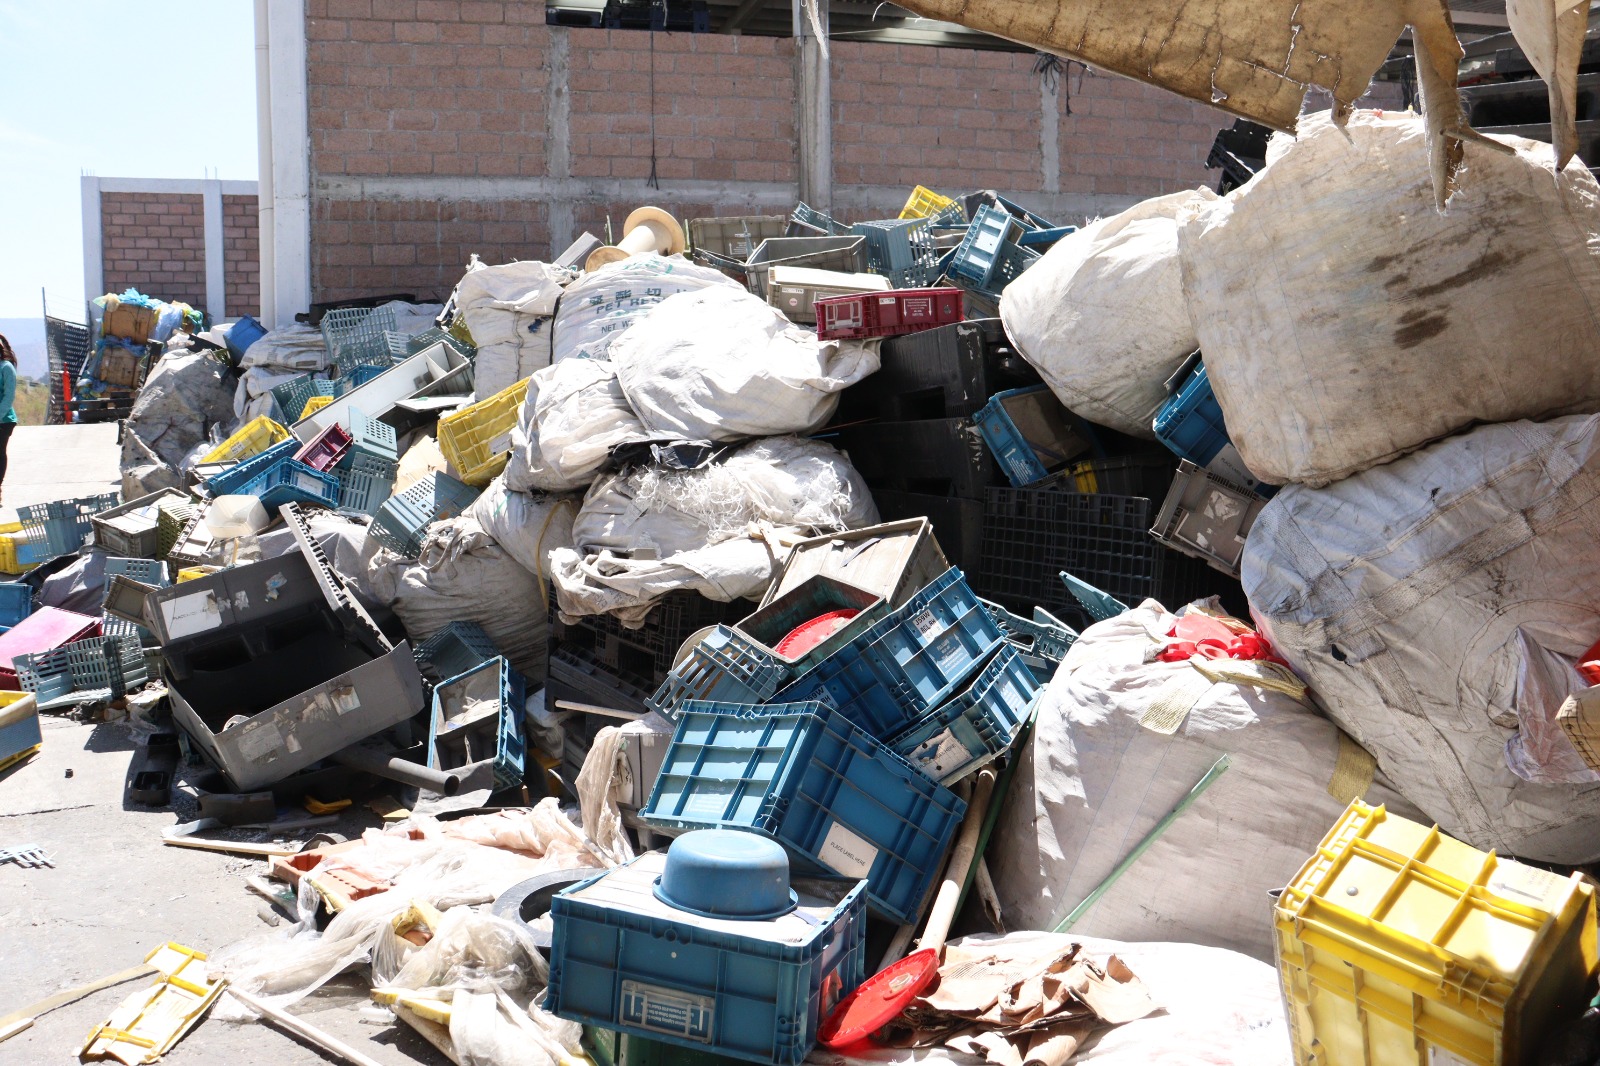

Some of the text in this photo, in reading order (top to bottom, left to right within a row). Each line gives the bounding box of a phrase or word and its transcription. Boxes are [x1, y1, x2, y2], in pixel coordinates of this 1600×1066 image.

[596, 300, 624, 314] PET
[601, 323, 617, 333] NET
[830, 842, 866, 866] PLACE LABEL HERE
